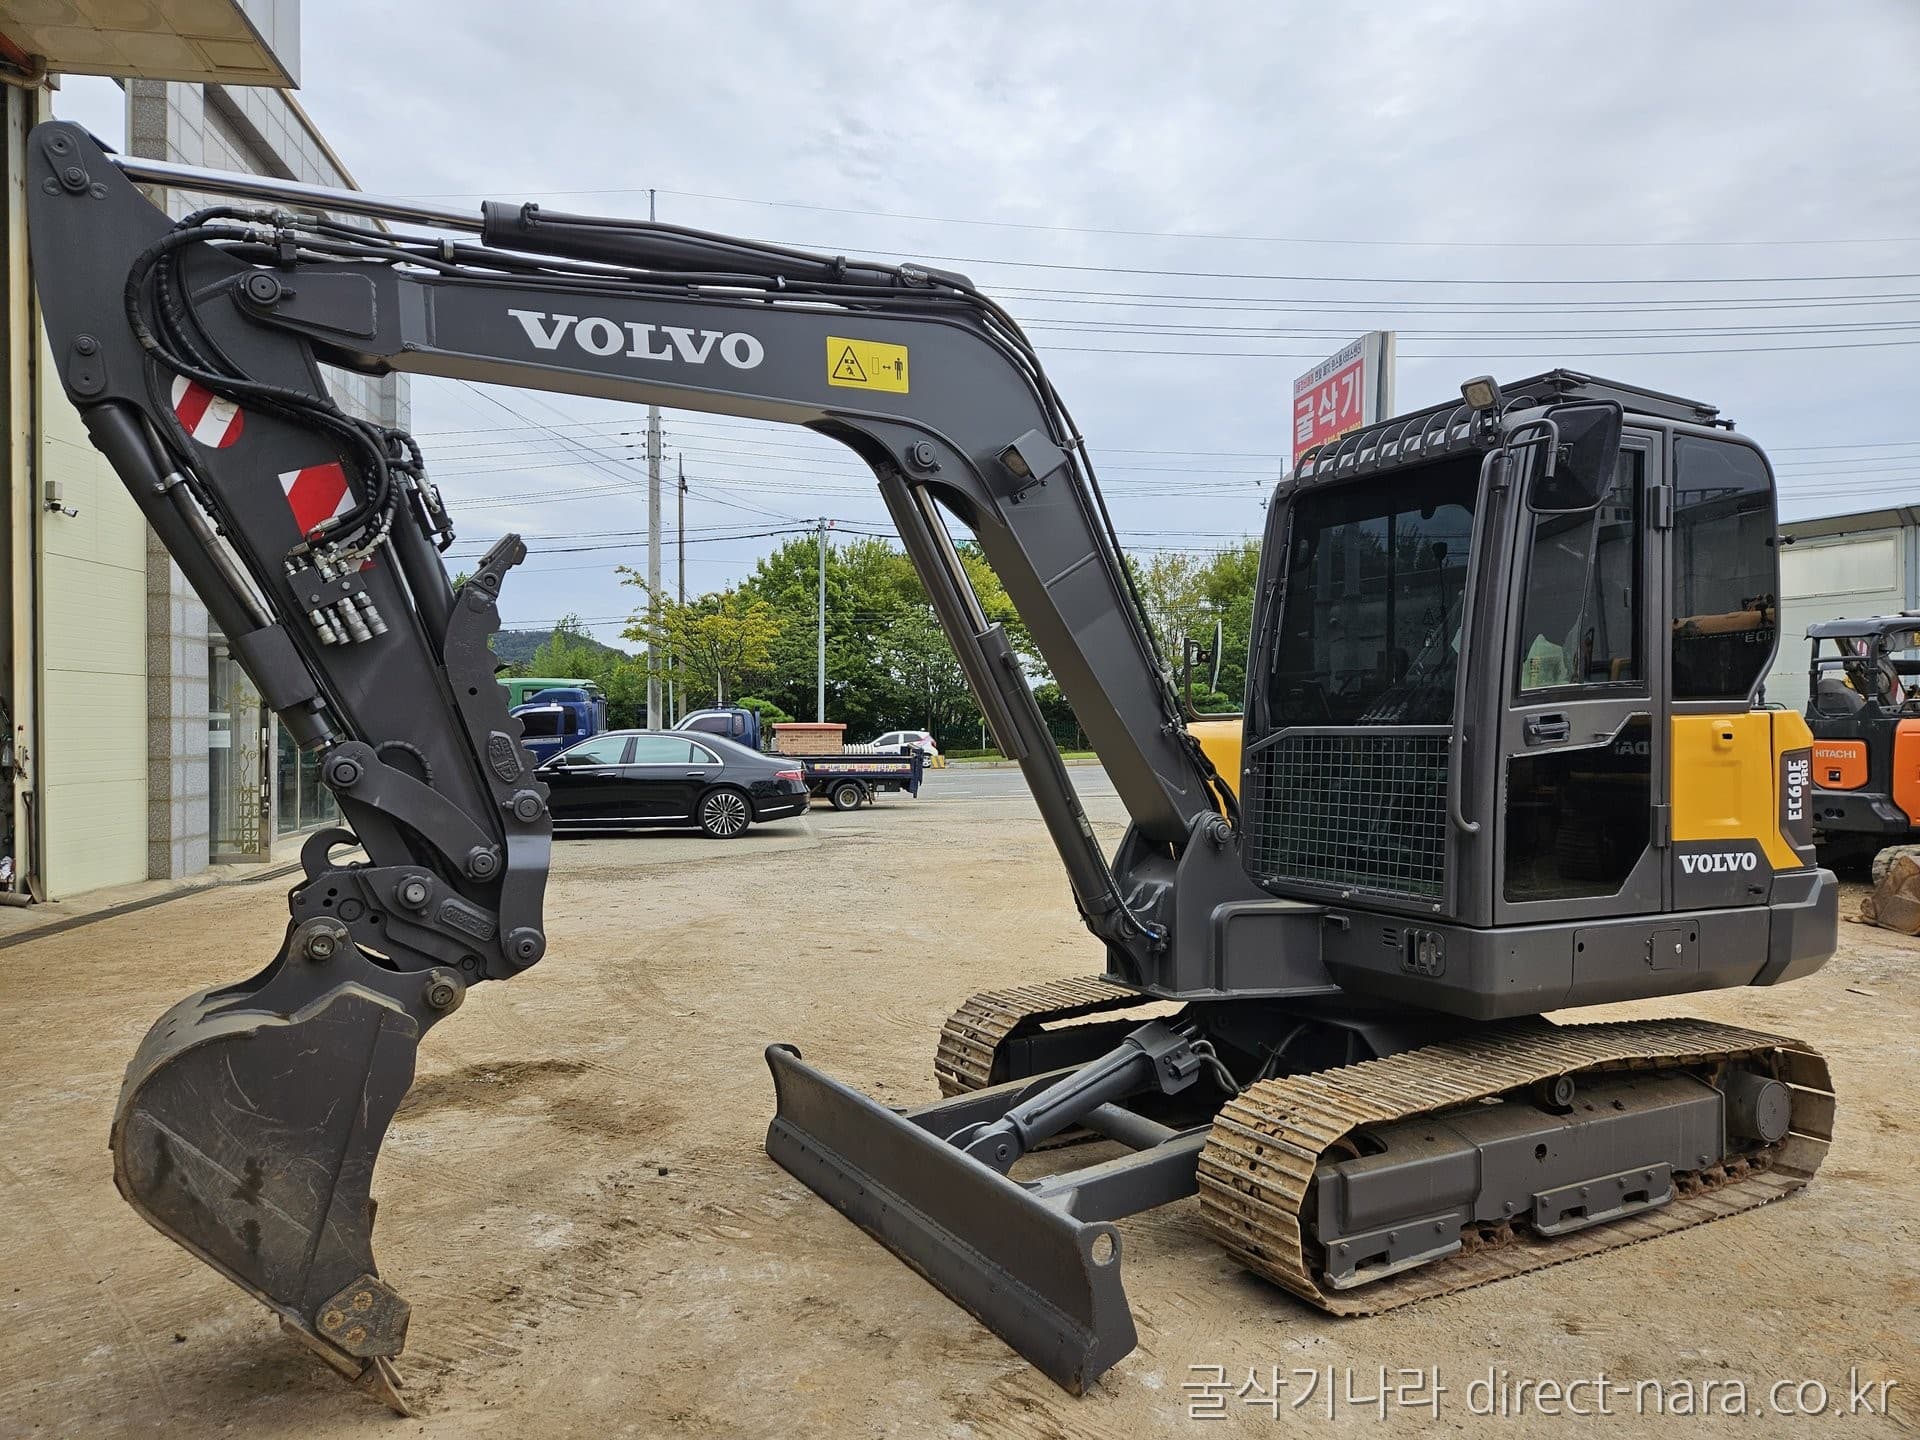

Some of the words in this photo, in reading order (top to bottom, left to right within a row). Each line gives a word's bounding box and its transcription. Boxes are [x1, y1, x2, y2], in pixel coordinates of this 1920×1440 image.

[508, 309, 764, 369] VOLVO
[1297, 366, 1361, 445] 굴삭기
[1801, 759, 1809, 786] PRO
[1815, 749, 1856, 759] HITACHI
[1788, 760, 1802, 820] EC60E
[1679, 852, 1757, 874] VOLVO
